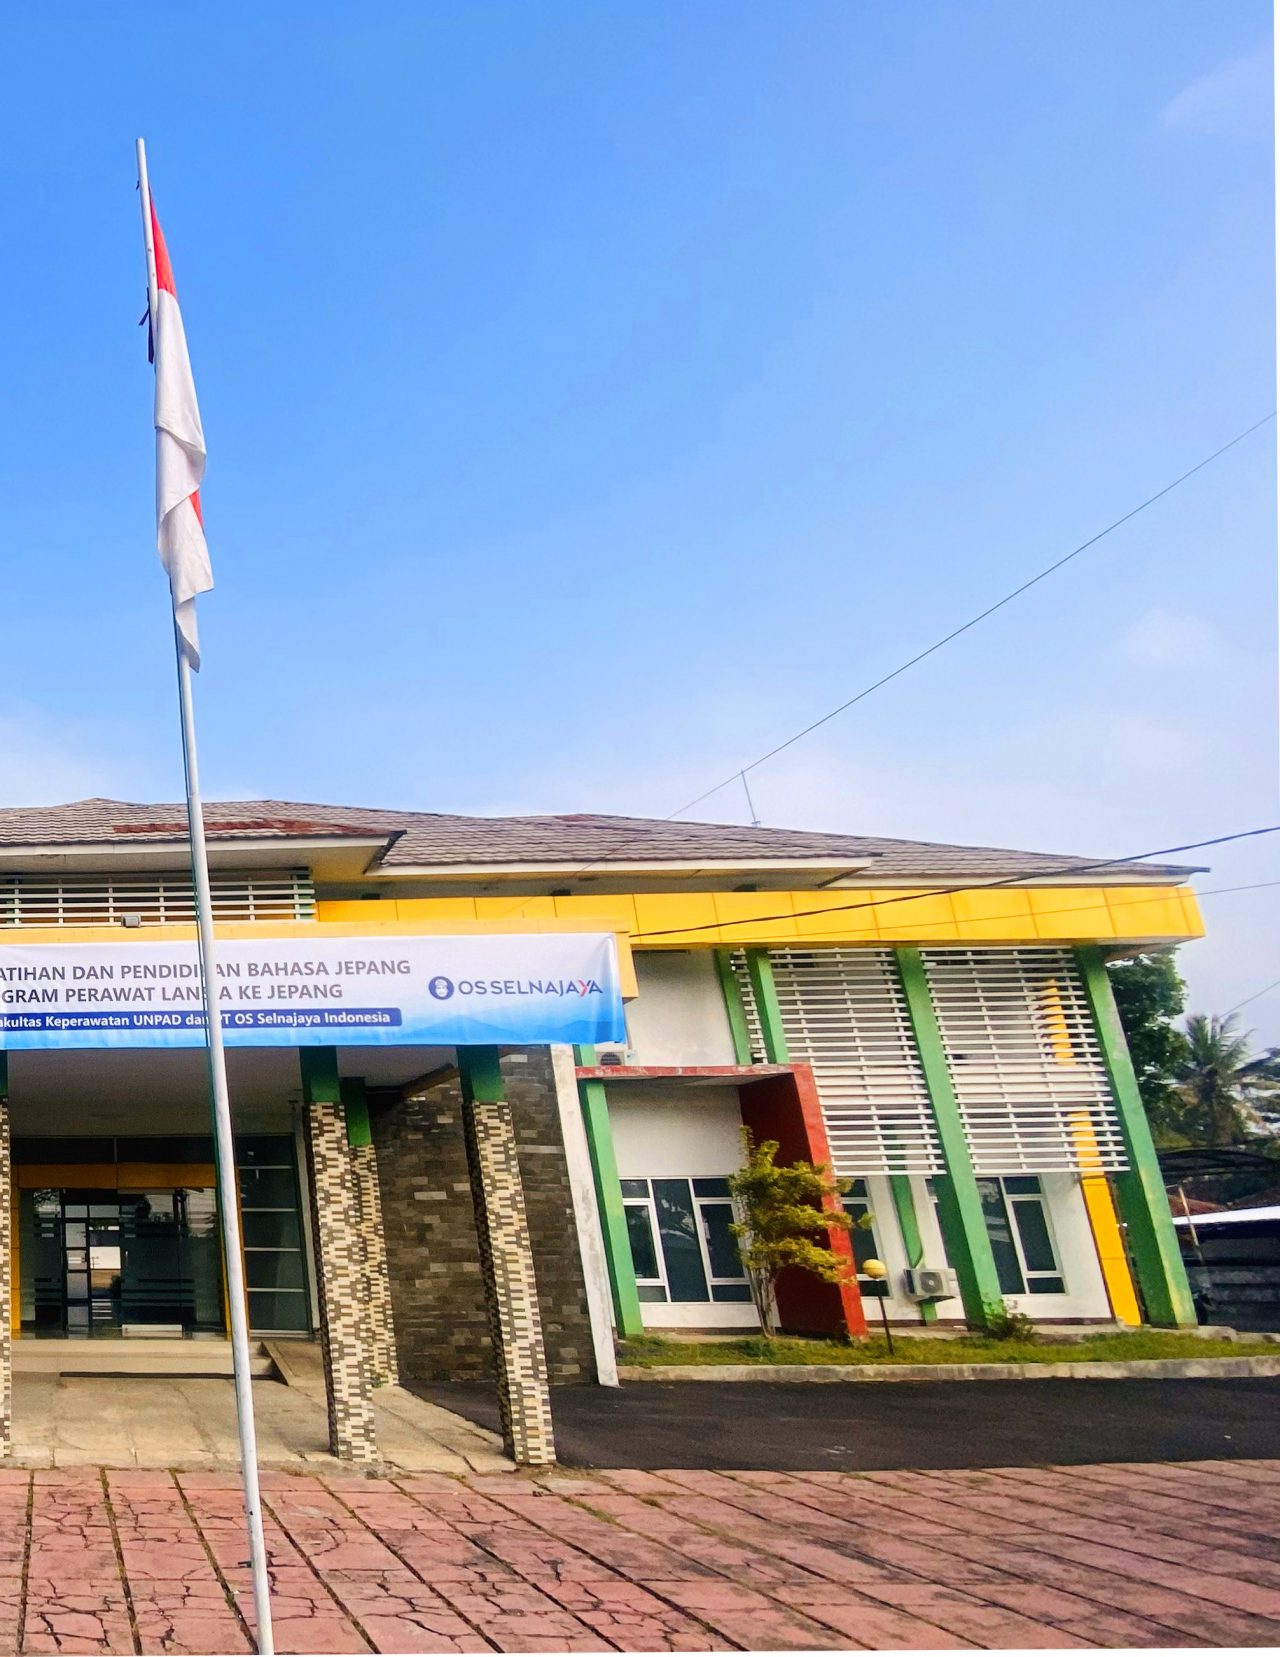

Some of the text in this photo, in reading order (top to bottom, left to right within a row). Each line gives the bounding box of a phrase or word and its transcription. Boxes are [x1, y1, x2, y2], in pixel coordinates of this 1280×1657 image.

[72, 965, 114, 980] DAN
[120, 963, 241, 979] PENDIDIAN
[247, 961, 330, 977] BAHASA
[335, 960, 411, 976] JEPANG
[65, 987, 156, 1003] PERAWAT
[238, 985, 261, 1000] KE
[267, 984, 343, 1000] JEPANG
[45, 1015, 130, 1029] Keperawatan
[133, 1014, 182, 1026] UNPAD
[234, 1013, 254, 1025] OS
[257, 1012, 321, 1027] Selnajaya
[324, 1011, 391, 1024] Indonesia
